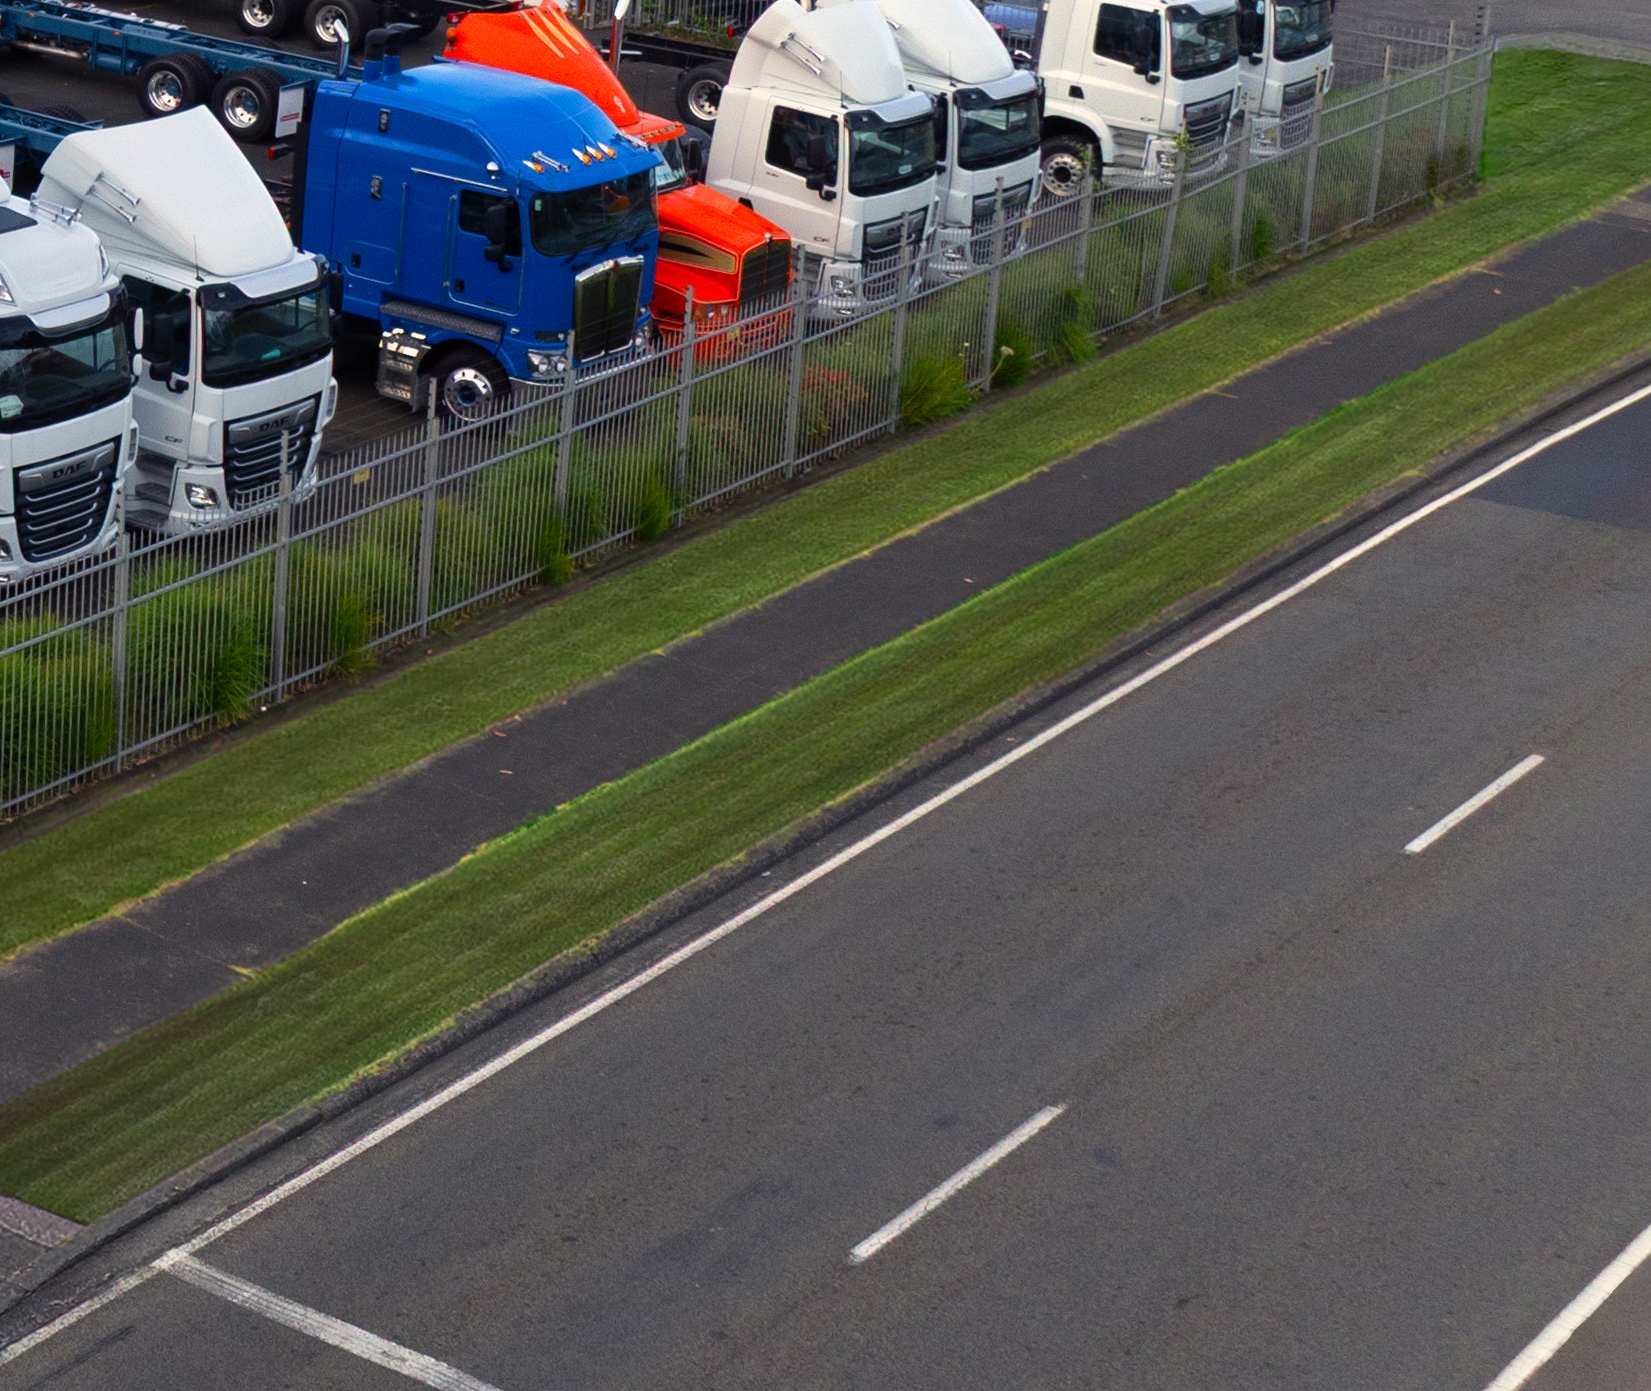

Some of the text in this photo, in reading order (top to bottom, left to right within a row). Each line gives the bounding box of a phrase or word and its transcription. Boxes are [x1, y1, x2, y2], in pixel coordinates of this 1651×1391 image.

[259, 415, 290, 433] DAF
[165, 435, 184, 444] CF
[52, 461, 87, 480] DAF
